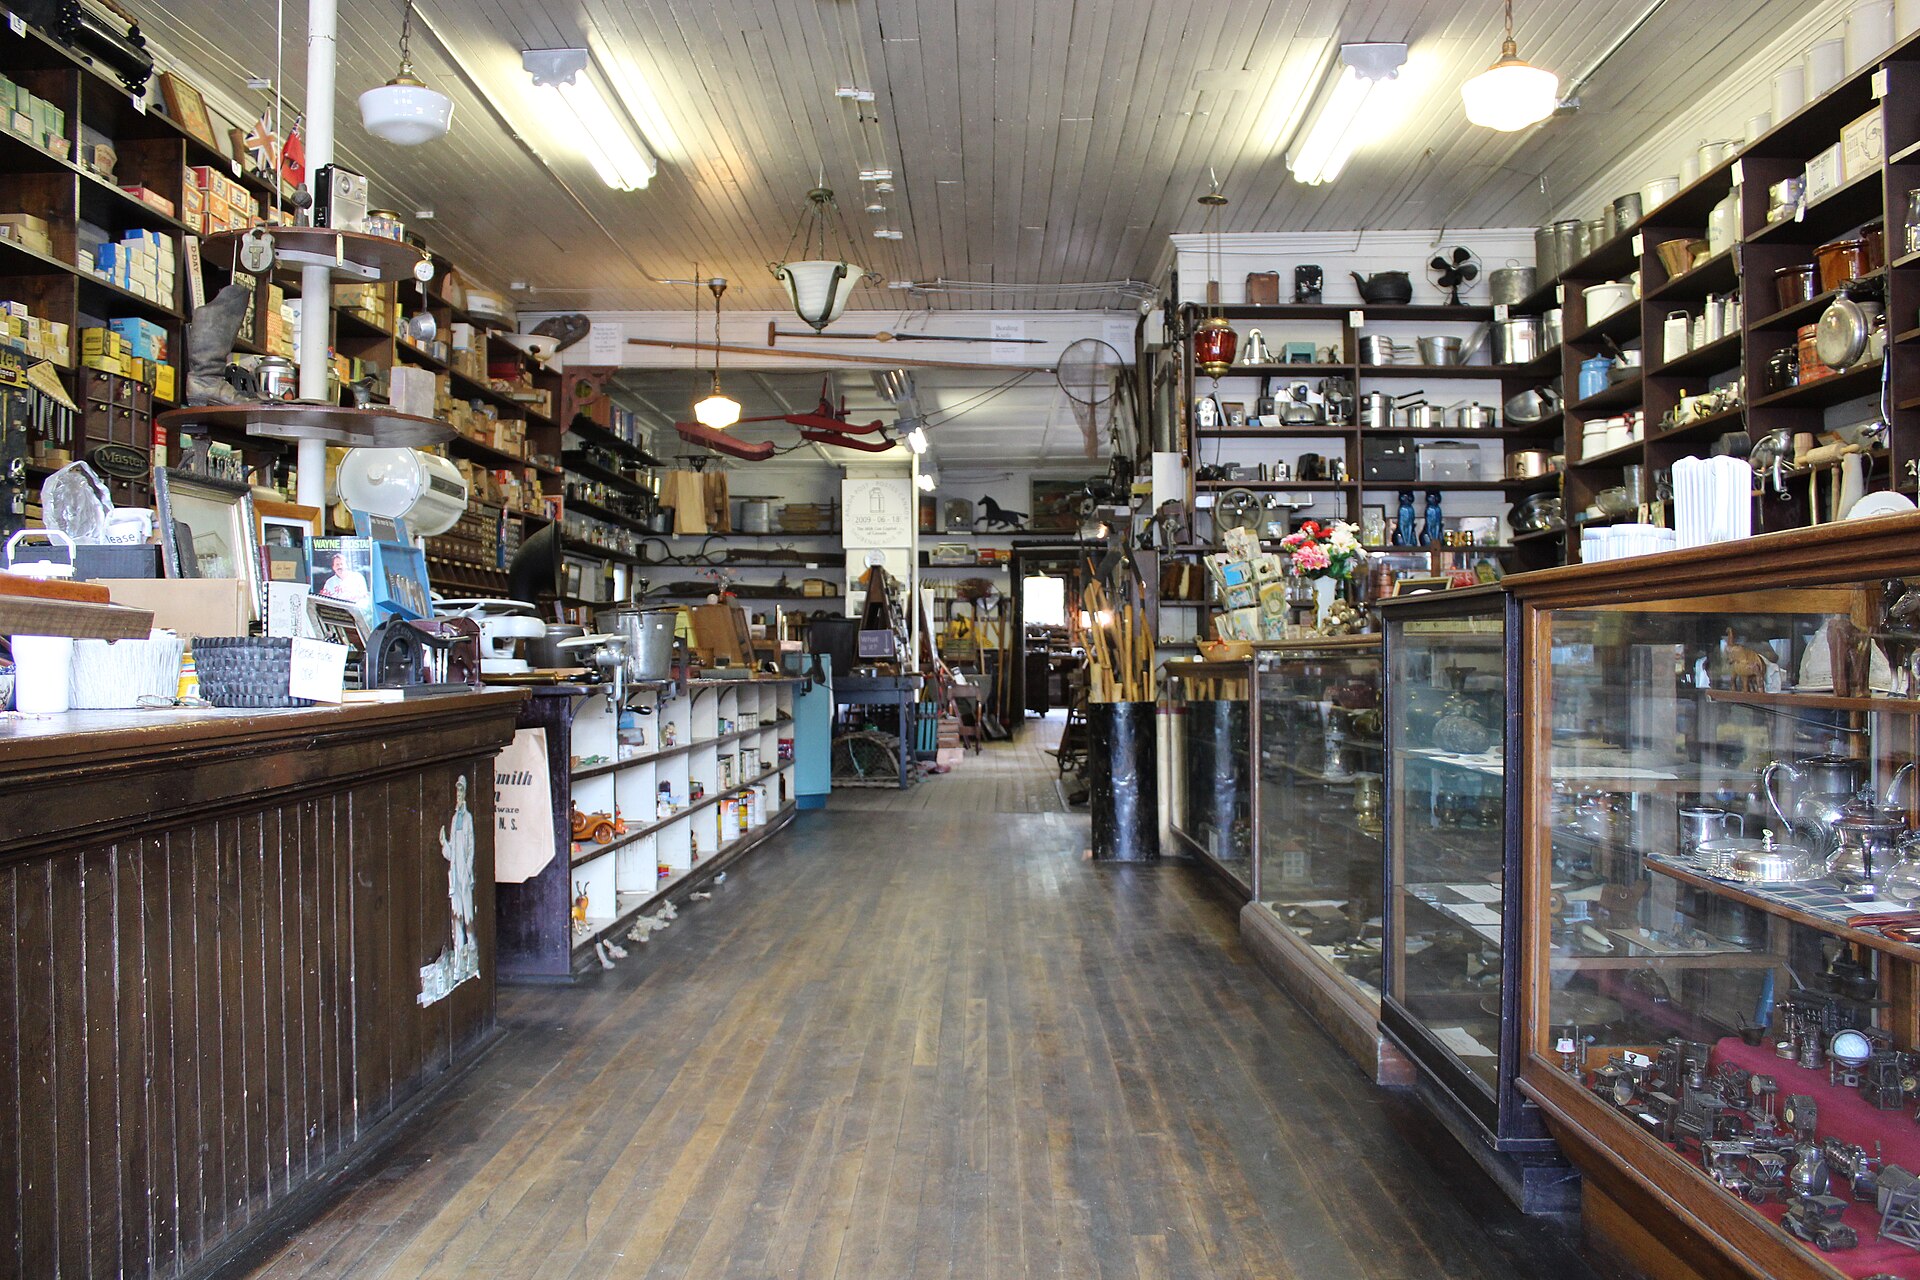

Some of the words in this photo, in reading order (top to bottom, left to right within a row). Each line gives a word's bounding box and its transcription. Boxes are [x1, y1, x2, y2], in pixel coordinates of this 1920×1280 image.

[101, 449, 146, 467] Master
[313, 539, 340, 549] WAYNE
[861, 635, 880, 643] What
[496, 770, 533, 786] mith
